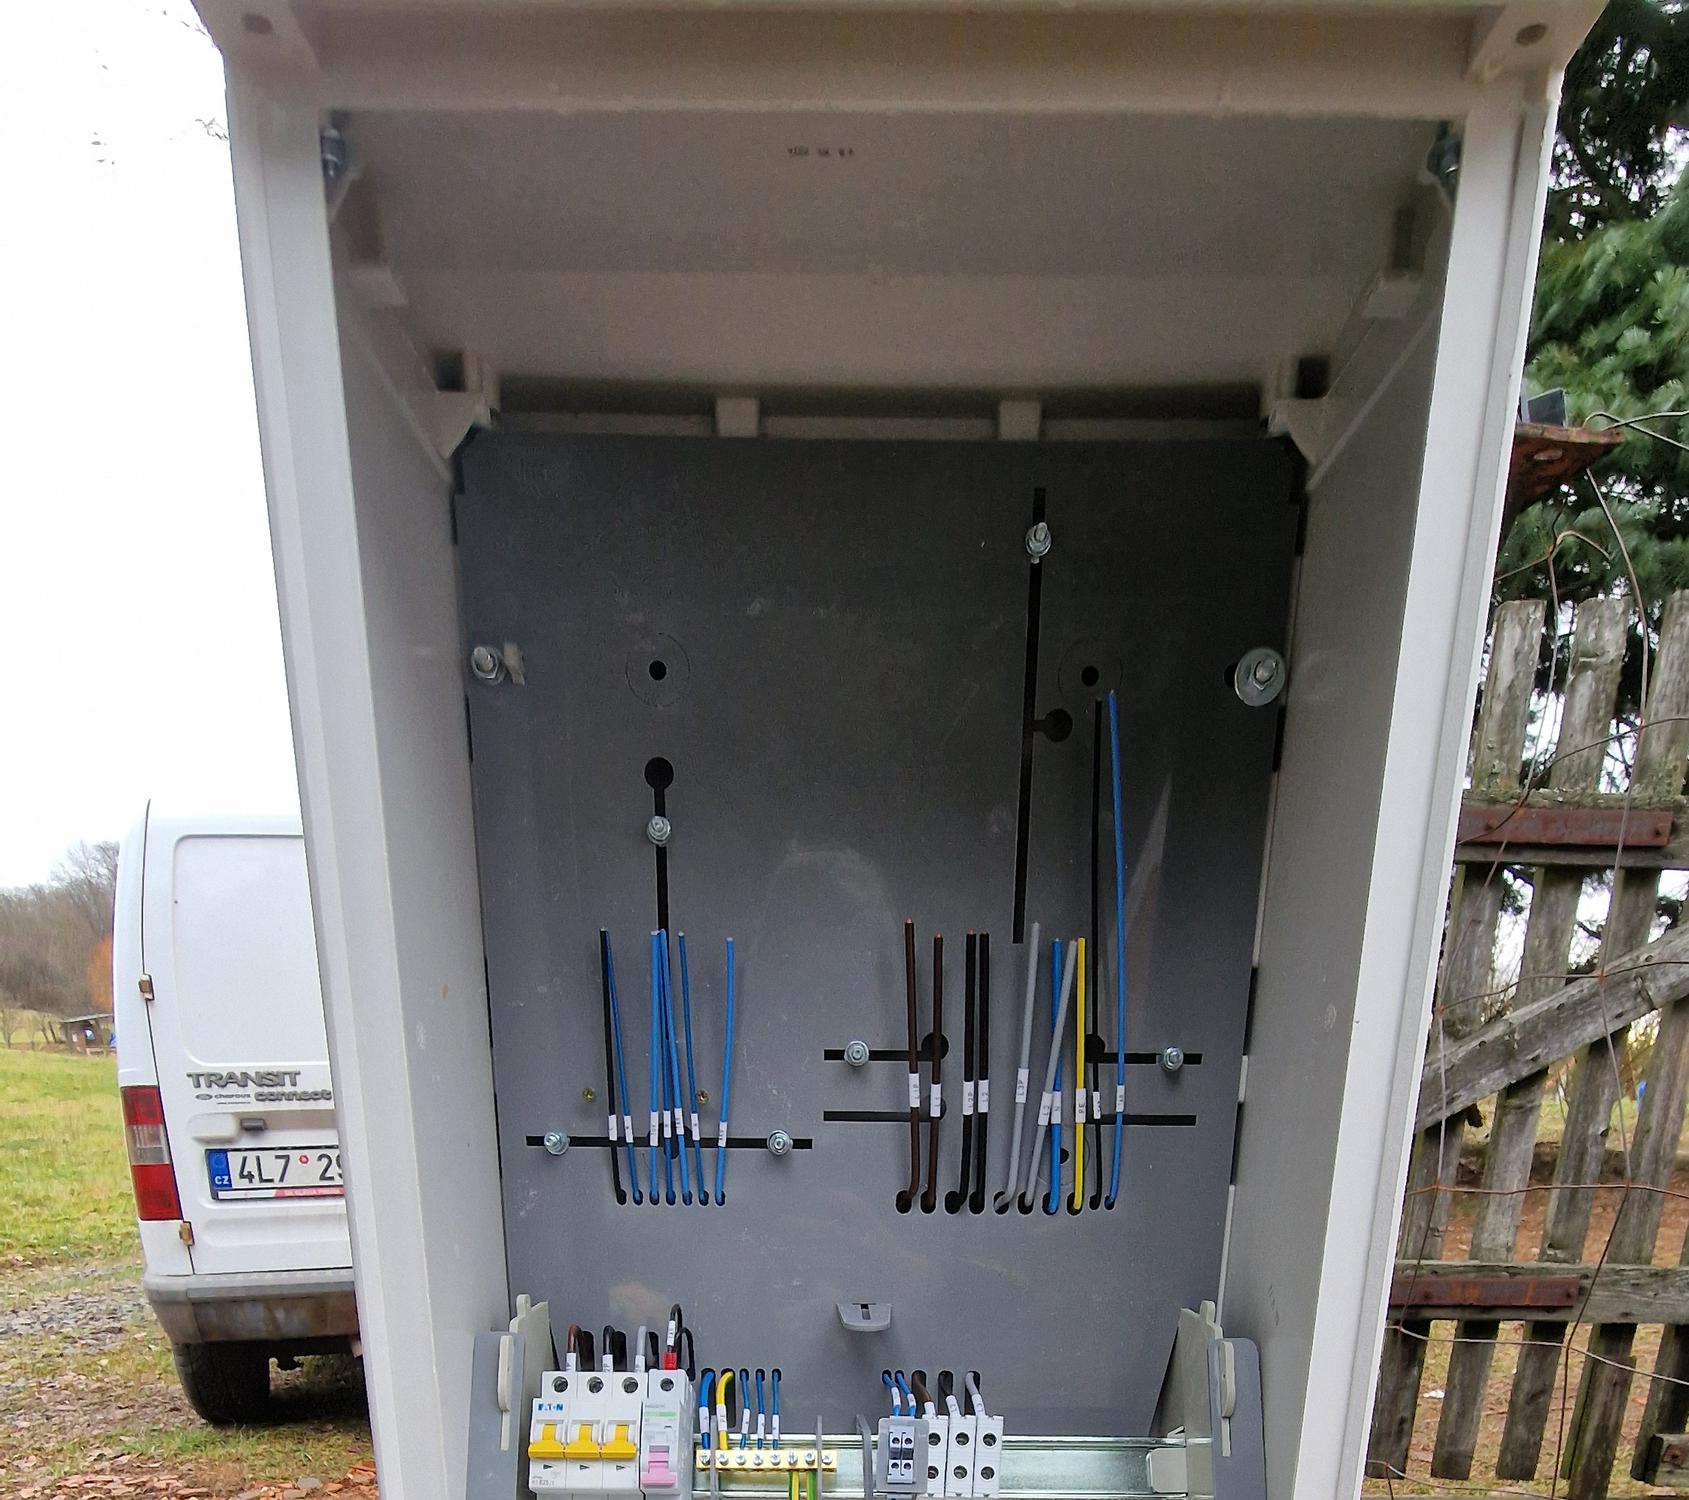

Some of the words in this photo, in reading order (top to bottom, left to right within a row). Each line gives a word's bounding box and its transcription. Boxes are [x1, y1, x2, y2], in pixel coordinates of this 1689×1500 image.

[186, 1070, 301, 1089] TRANSIT
[254, 1089, 332, 1102] connect
[238, 1154, 290, 1184] 4L7
[214, 1175, 230, 1185] CZ
